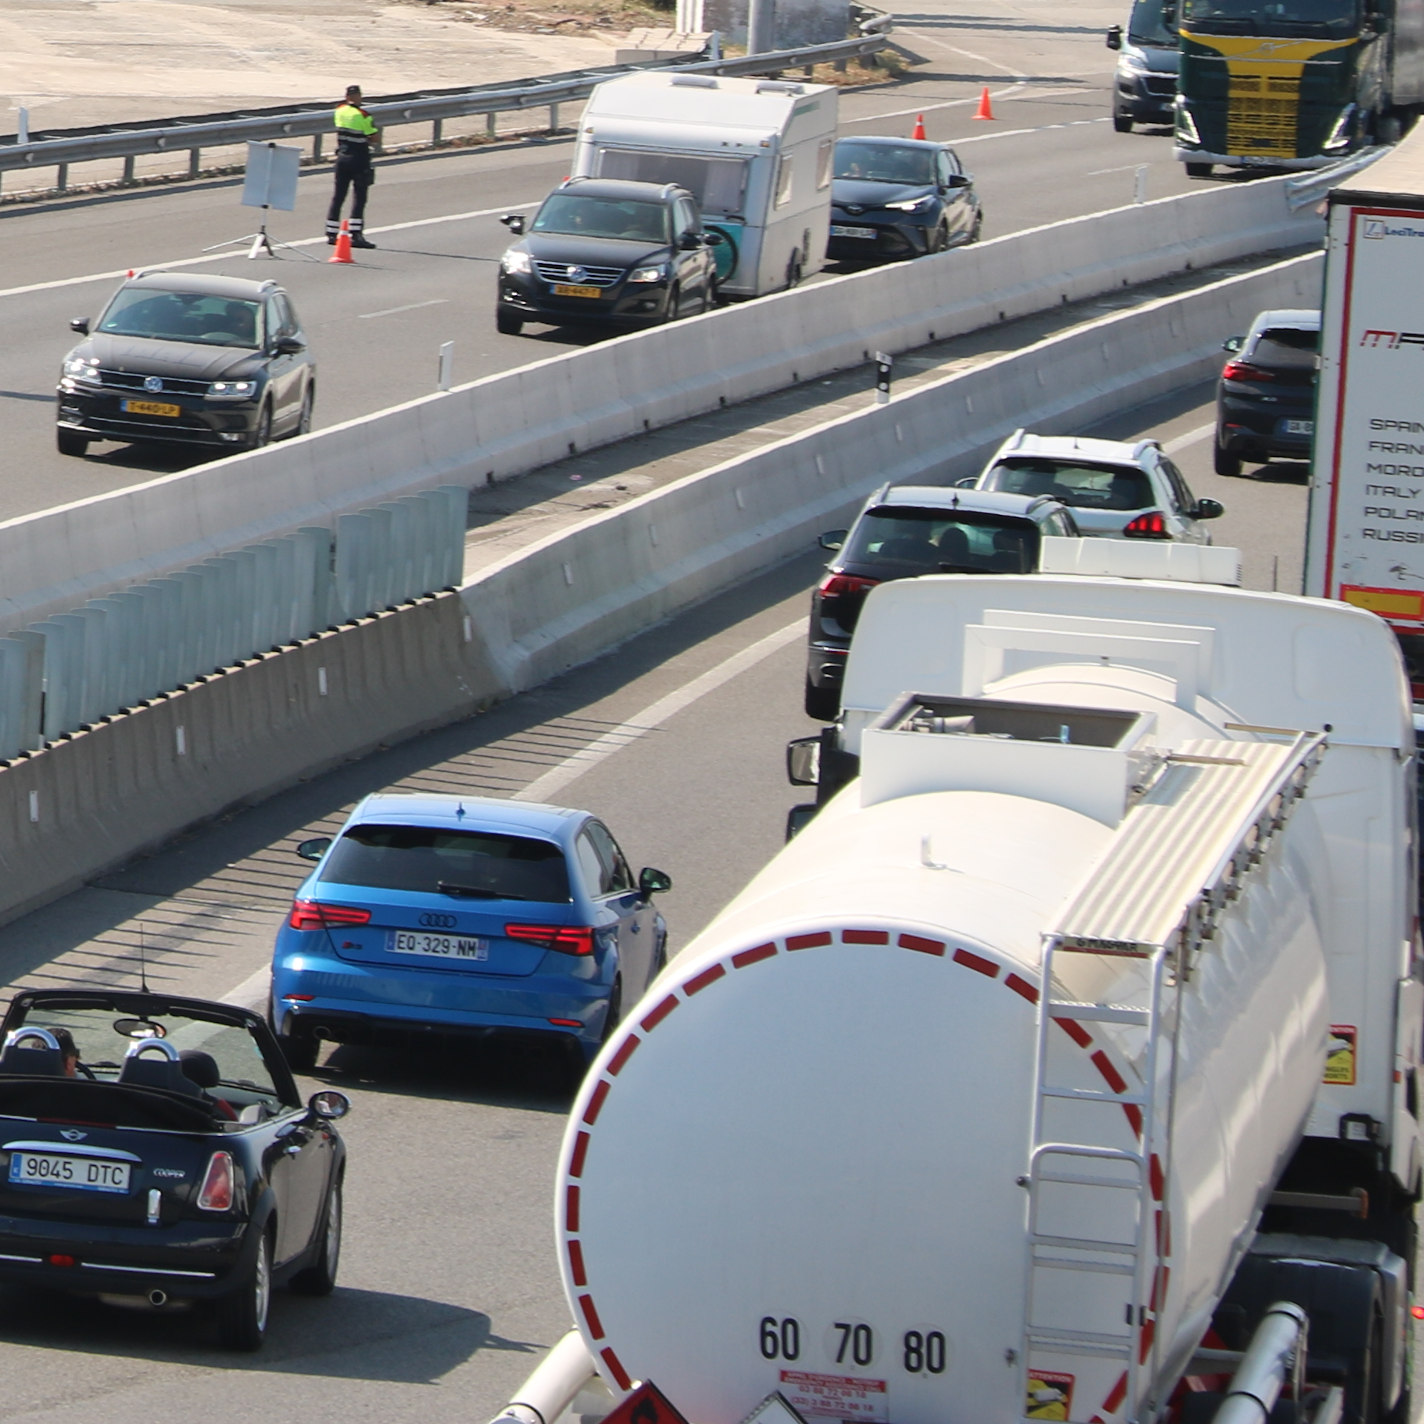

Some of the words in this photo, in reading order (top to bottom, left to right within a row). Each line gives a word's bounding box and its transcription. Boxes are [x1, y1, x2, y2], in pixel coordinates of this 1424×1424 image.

[1365, 484, 1422, 499] ITALY
[396, 934, 477, 957] EQ-329-NM
[26, 1158, 74, 1180] 9045
[87, 1163, 124, 1186] DTC
[760, 1316, 800, 1361] 60
[834, 1322, 873, 1366] 70
[904, 1330, 946, 1374] 80
